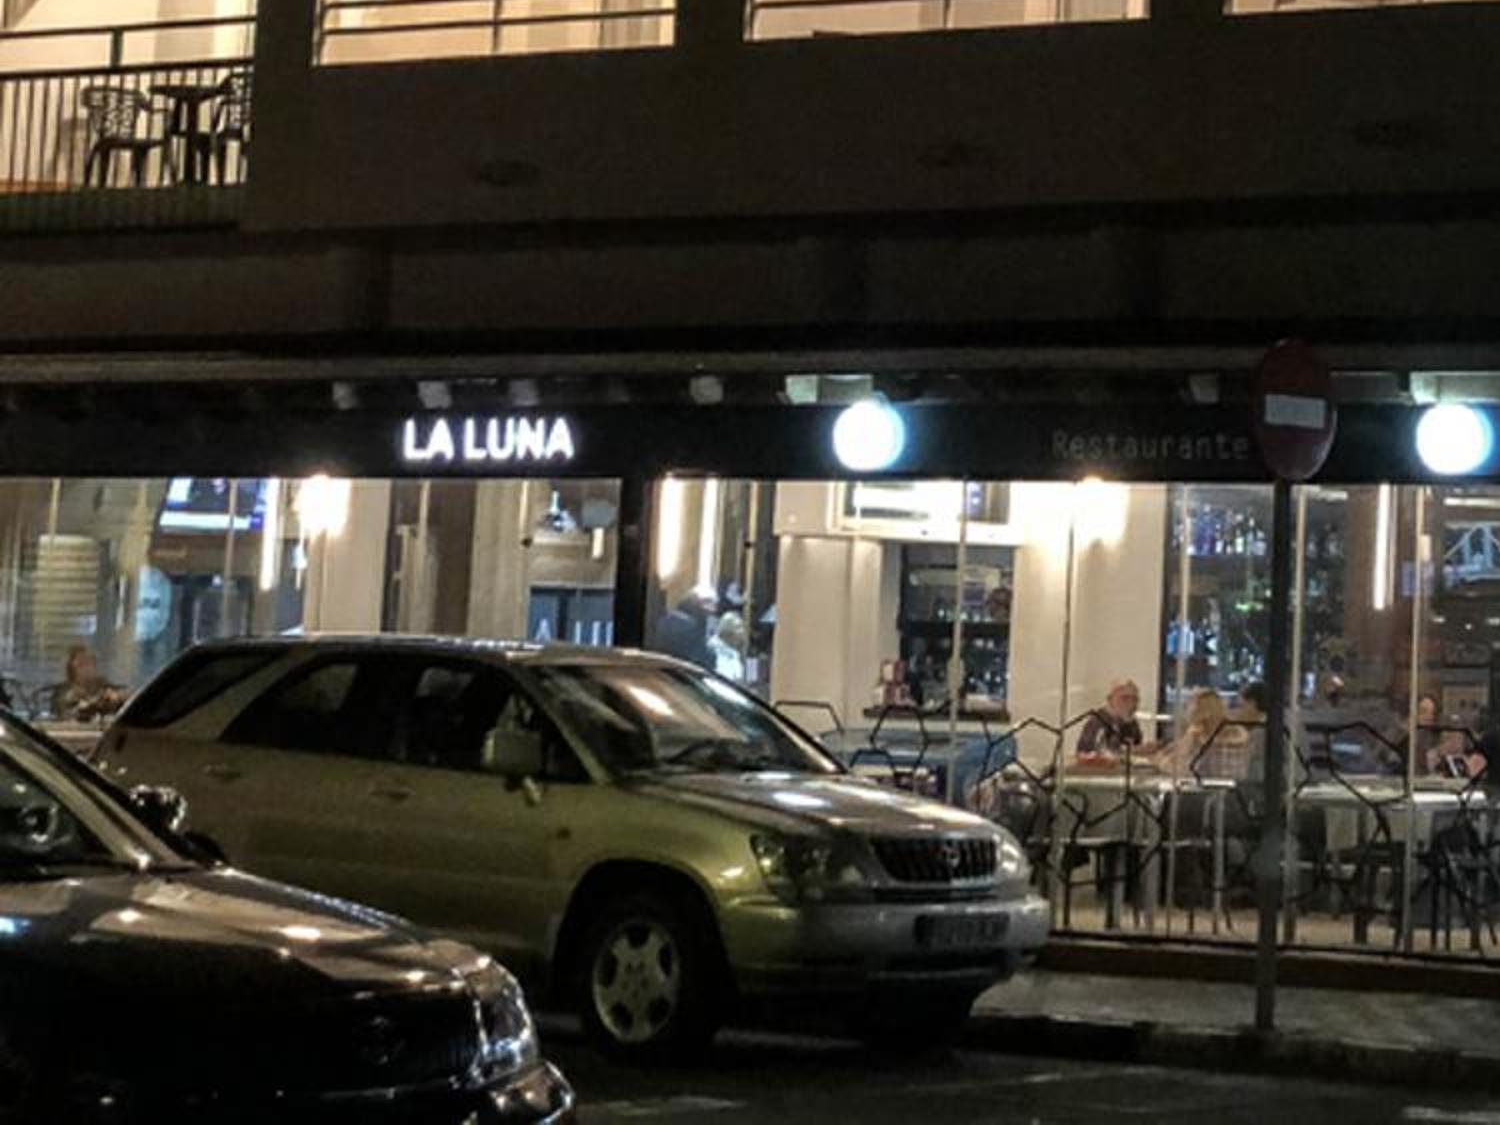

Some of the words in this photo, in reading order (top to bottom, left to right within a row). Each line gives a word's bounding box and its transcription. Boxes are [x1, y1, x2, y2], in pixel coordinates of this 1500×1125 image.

[404, 416, 455, 461] LA
[463, 416, 575, 461] LUNA
[1052, 429, 1249, 461] Restaurante
